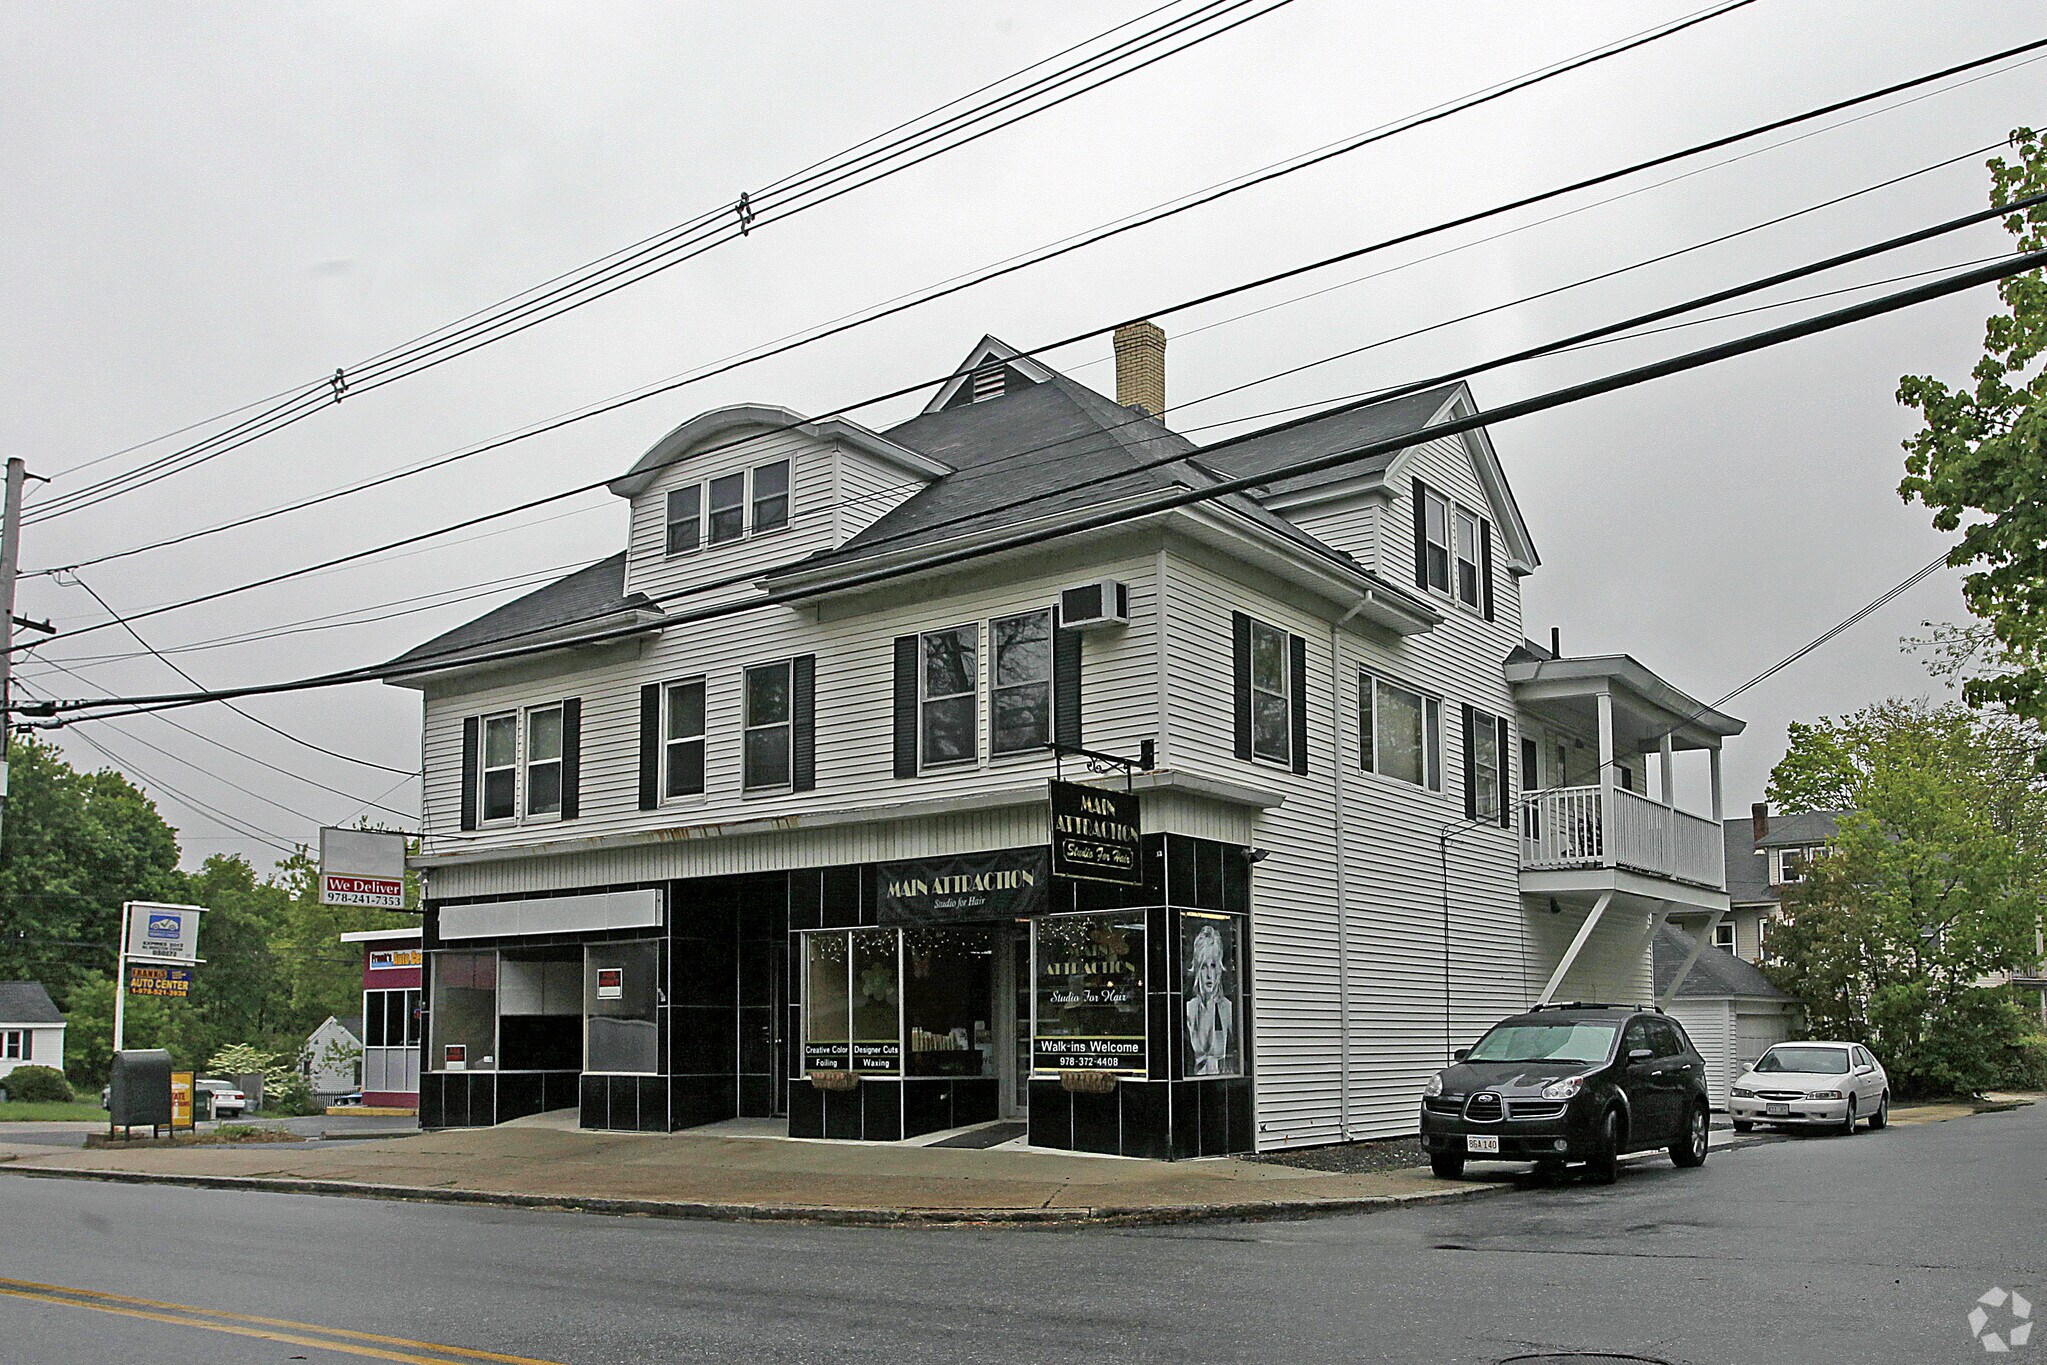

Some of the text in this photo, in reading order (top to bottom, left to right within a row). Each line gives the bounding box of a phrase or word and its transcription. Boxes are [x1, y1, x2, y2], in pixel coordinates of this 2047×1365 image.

[1080, 794, 1116, 817] MAIN
[1056, 814, 1139, 843] ATTRACTION
[1066, 843, 1130, 864] Studio For Hair
[329, 878, 400, 894] We Deliver
[887, 868, 1035, 898] MAIN ATTRACTION
[327, 892, 401, 906] 978-241-7353
[934, 896, 986, 909] Studio for Hair
[1045, 961, 1135, 975] ATTRACTION
[131, 978, 189, 990] AUTO CENTER
[1050, 989, 1128, 1003] Studio For Hair
[805, 1045, 848, 1054] Creative Color
[854, 1045, 899, 1055] Designer Cuts
[1041, 1040, 1139, 1053] Walk-ins Welcome
[816, 1059, 838, 1068] Foiling
[863, 1059, 890, 1069] Waxing
[1060, 1057, 1119, 1067] 978-372-4408
